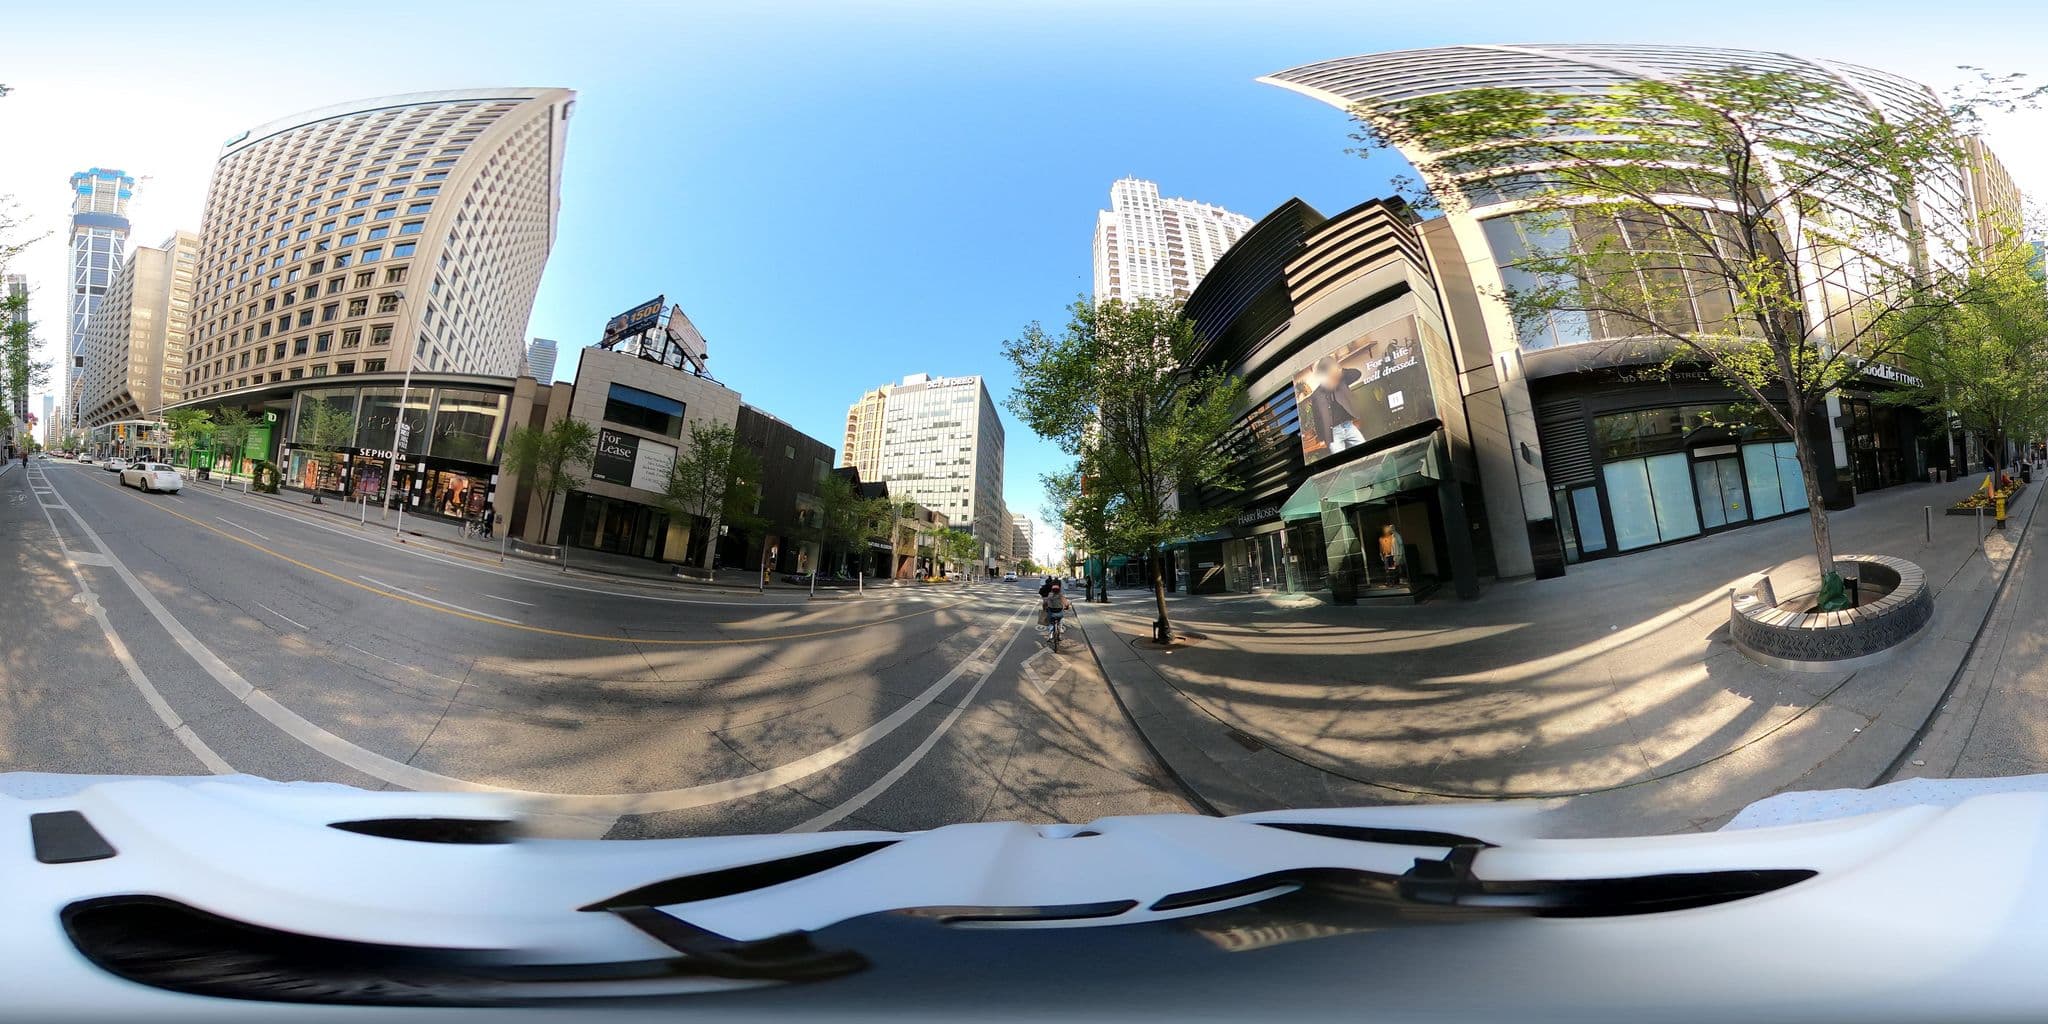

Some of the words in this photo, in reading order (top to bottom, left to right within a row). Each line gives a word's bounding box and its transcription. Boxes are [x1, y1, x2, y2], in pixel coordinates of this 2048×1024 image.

[1366, 359, 1383, 369] For
[1392, 347, 1409, 359] life
[1363, 370, 1380, 384] well
[267, 412, 277, 422] TD
[601, 431, 622, 444] For
[360, 448, 406, 461] SEPHORA
[600, 441, 632, 458] Lease
